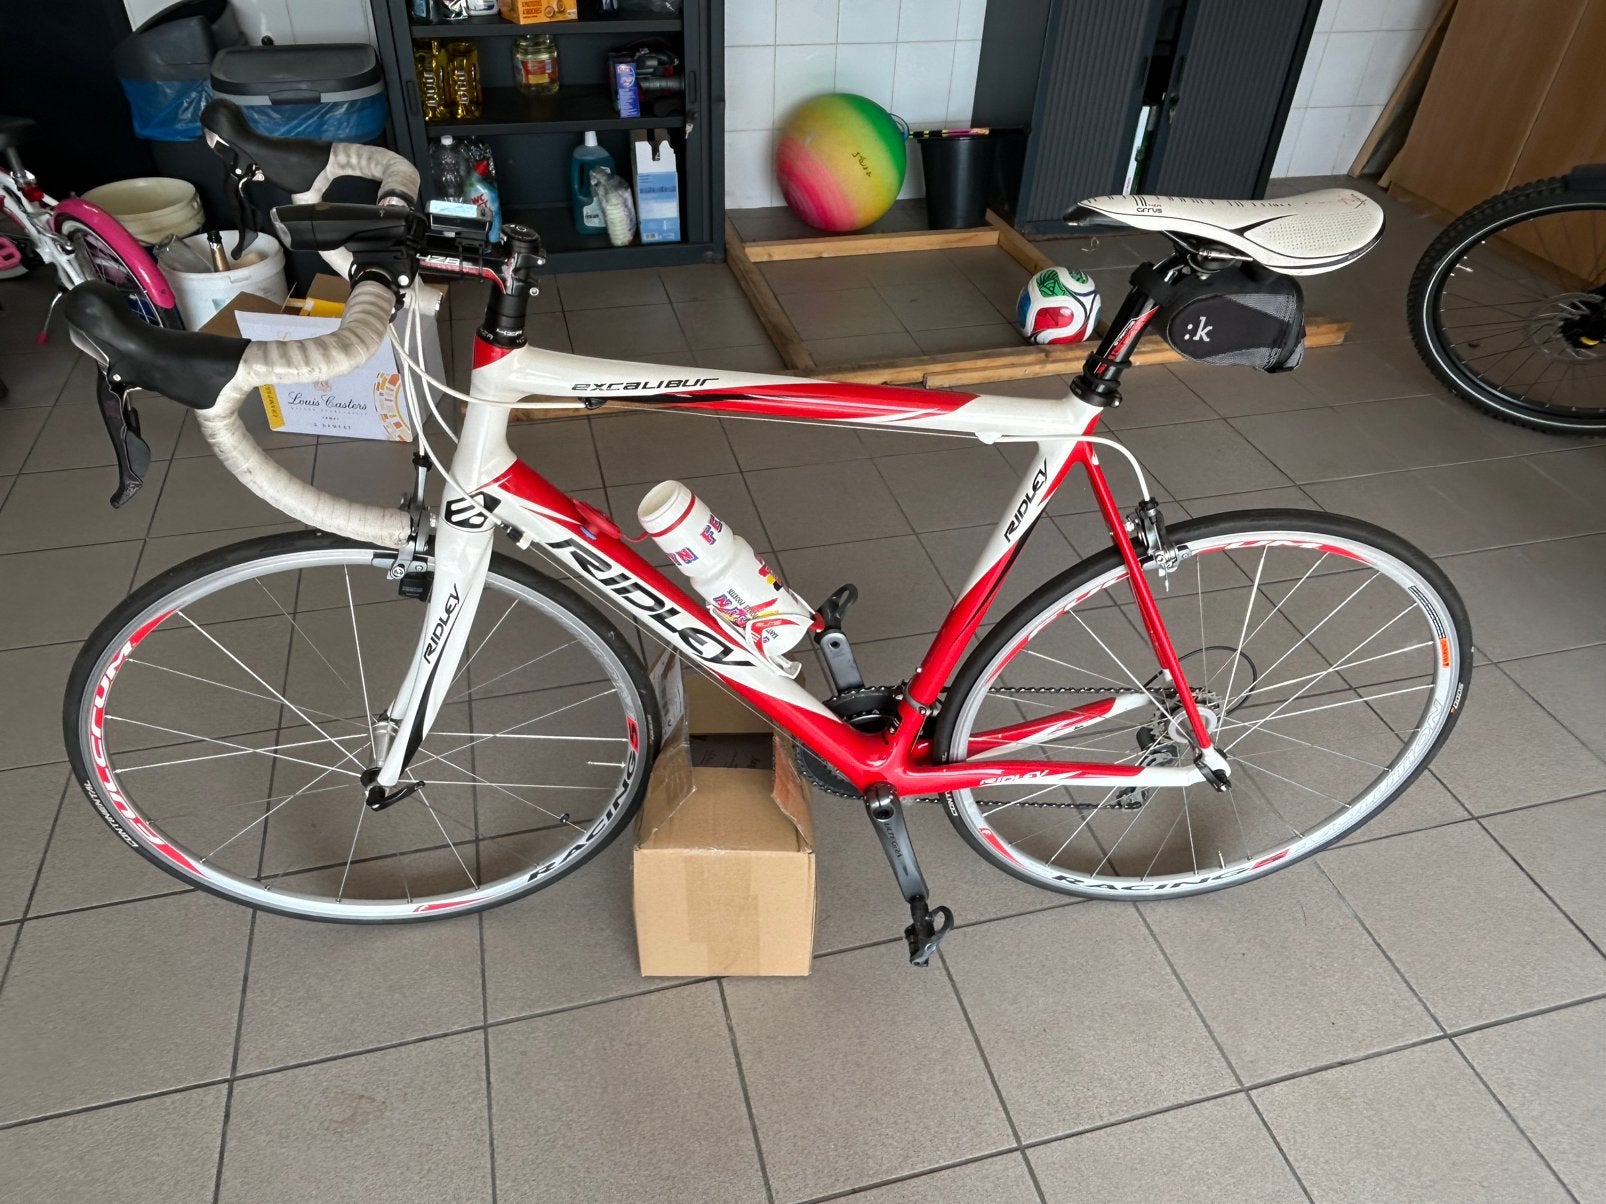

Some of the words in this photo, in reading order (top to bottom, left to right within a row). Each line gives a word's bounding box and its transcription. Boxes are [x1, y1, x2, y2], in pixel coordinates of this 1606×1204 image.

[288, 391, 321, 407] Louis
[320, 394, 368, 411] Casters
[1004, 457, 1048, 543] RIDLEY
[423, 583, 460, 664] RIDLEY
[546, 538, 756, 667] RIDLEY
[83, 780, 139, 848] CONTINENTAL
[978, 770, 1049, 787] RIDLEY
[527, 750, 637, 883] RACING
[1052, 867, 1249, 891] RACING
